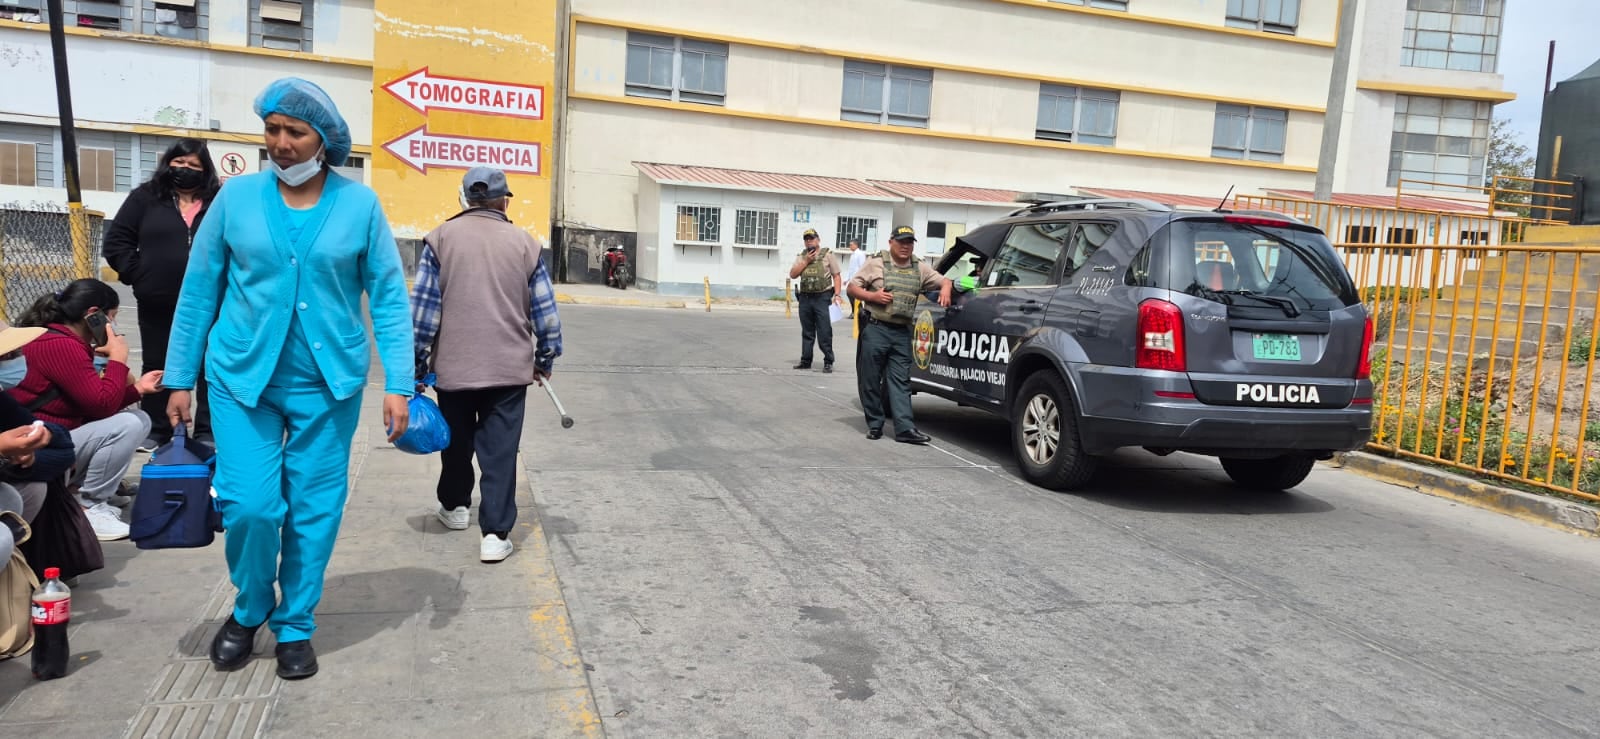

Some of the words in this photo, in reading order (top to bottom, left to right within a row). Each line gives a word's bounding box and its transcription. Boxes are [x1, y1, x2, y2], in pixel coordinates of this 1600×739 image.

[406, 81, 537, 111] TOMOGRAFIA
[409, 139, 533, 167] EMERGENCIA
[936, 330, 1009, 363] POLICIA
[929, 363, 960, 379] COMISARIA
[960, 368, 986, 382] PALACIO
[987, 371, 1006, 386] VIEJO
[1236, 383, 1320, 403] POLICIA
